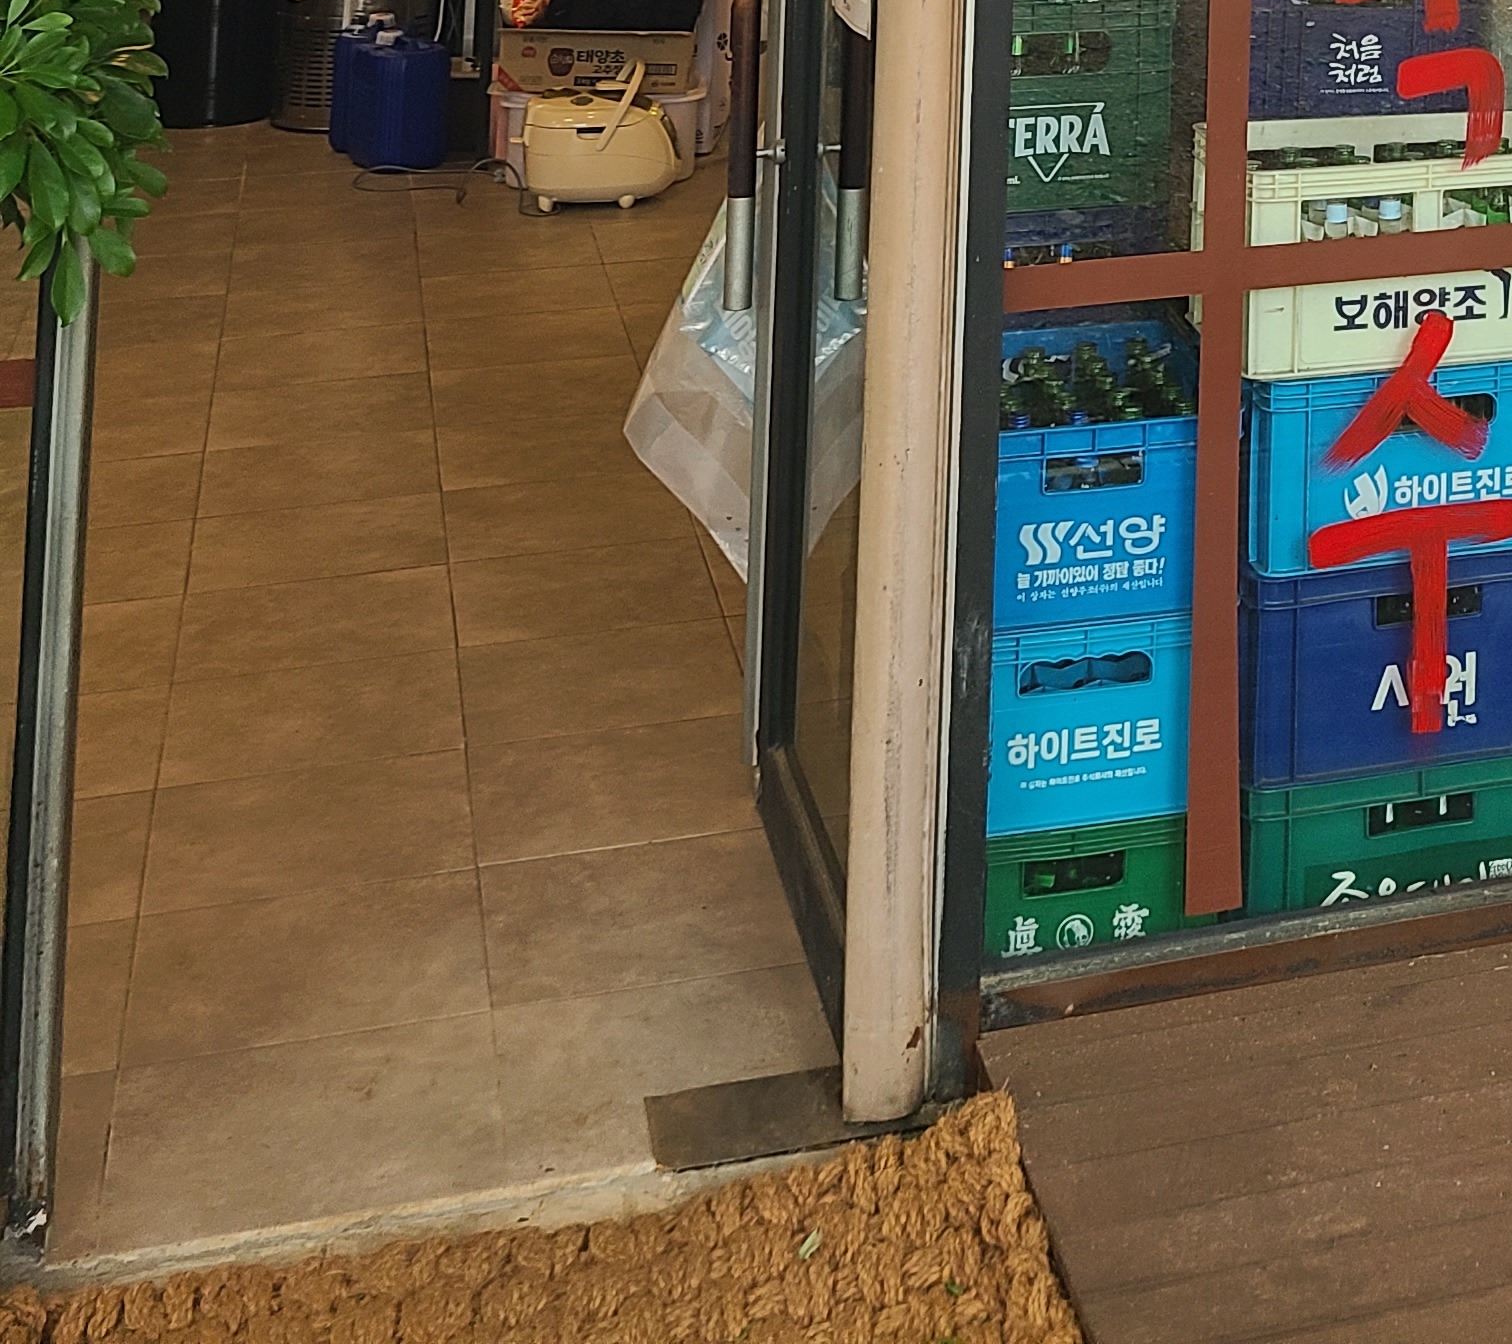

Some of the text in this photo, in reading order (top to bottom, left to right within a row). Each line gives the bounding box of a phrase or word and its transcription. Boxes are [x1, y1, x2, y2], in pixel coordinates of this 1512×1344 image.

[576, 50, 624, 64] 태양초
[1329, 32, 1382, 61] 처음
[1328, 62, 1382, 85] 처럼
[1333, 285, 1486, 331] 보해양조
[1068, 514, 1166, 560] 선양
[1007, 718, 1163, 769] 하이트진로
